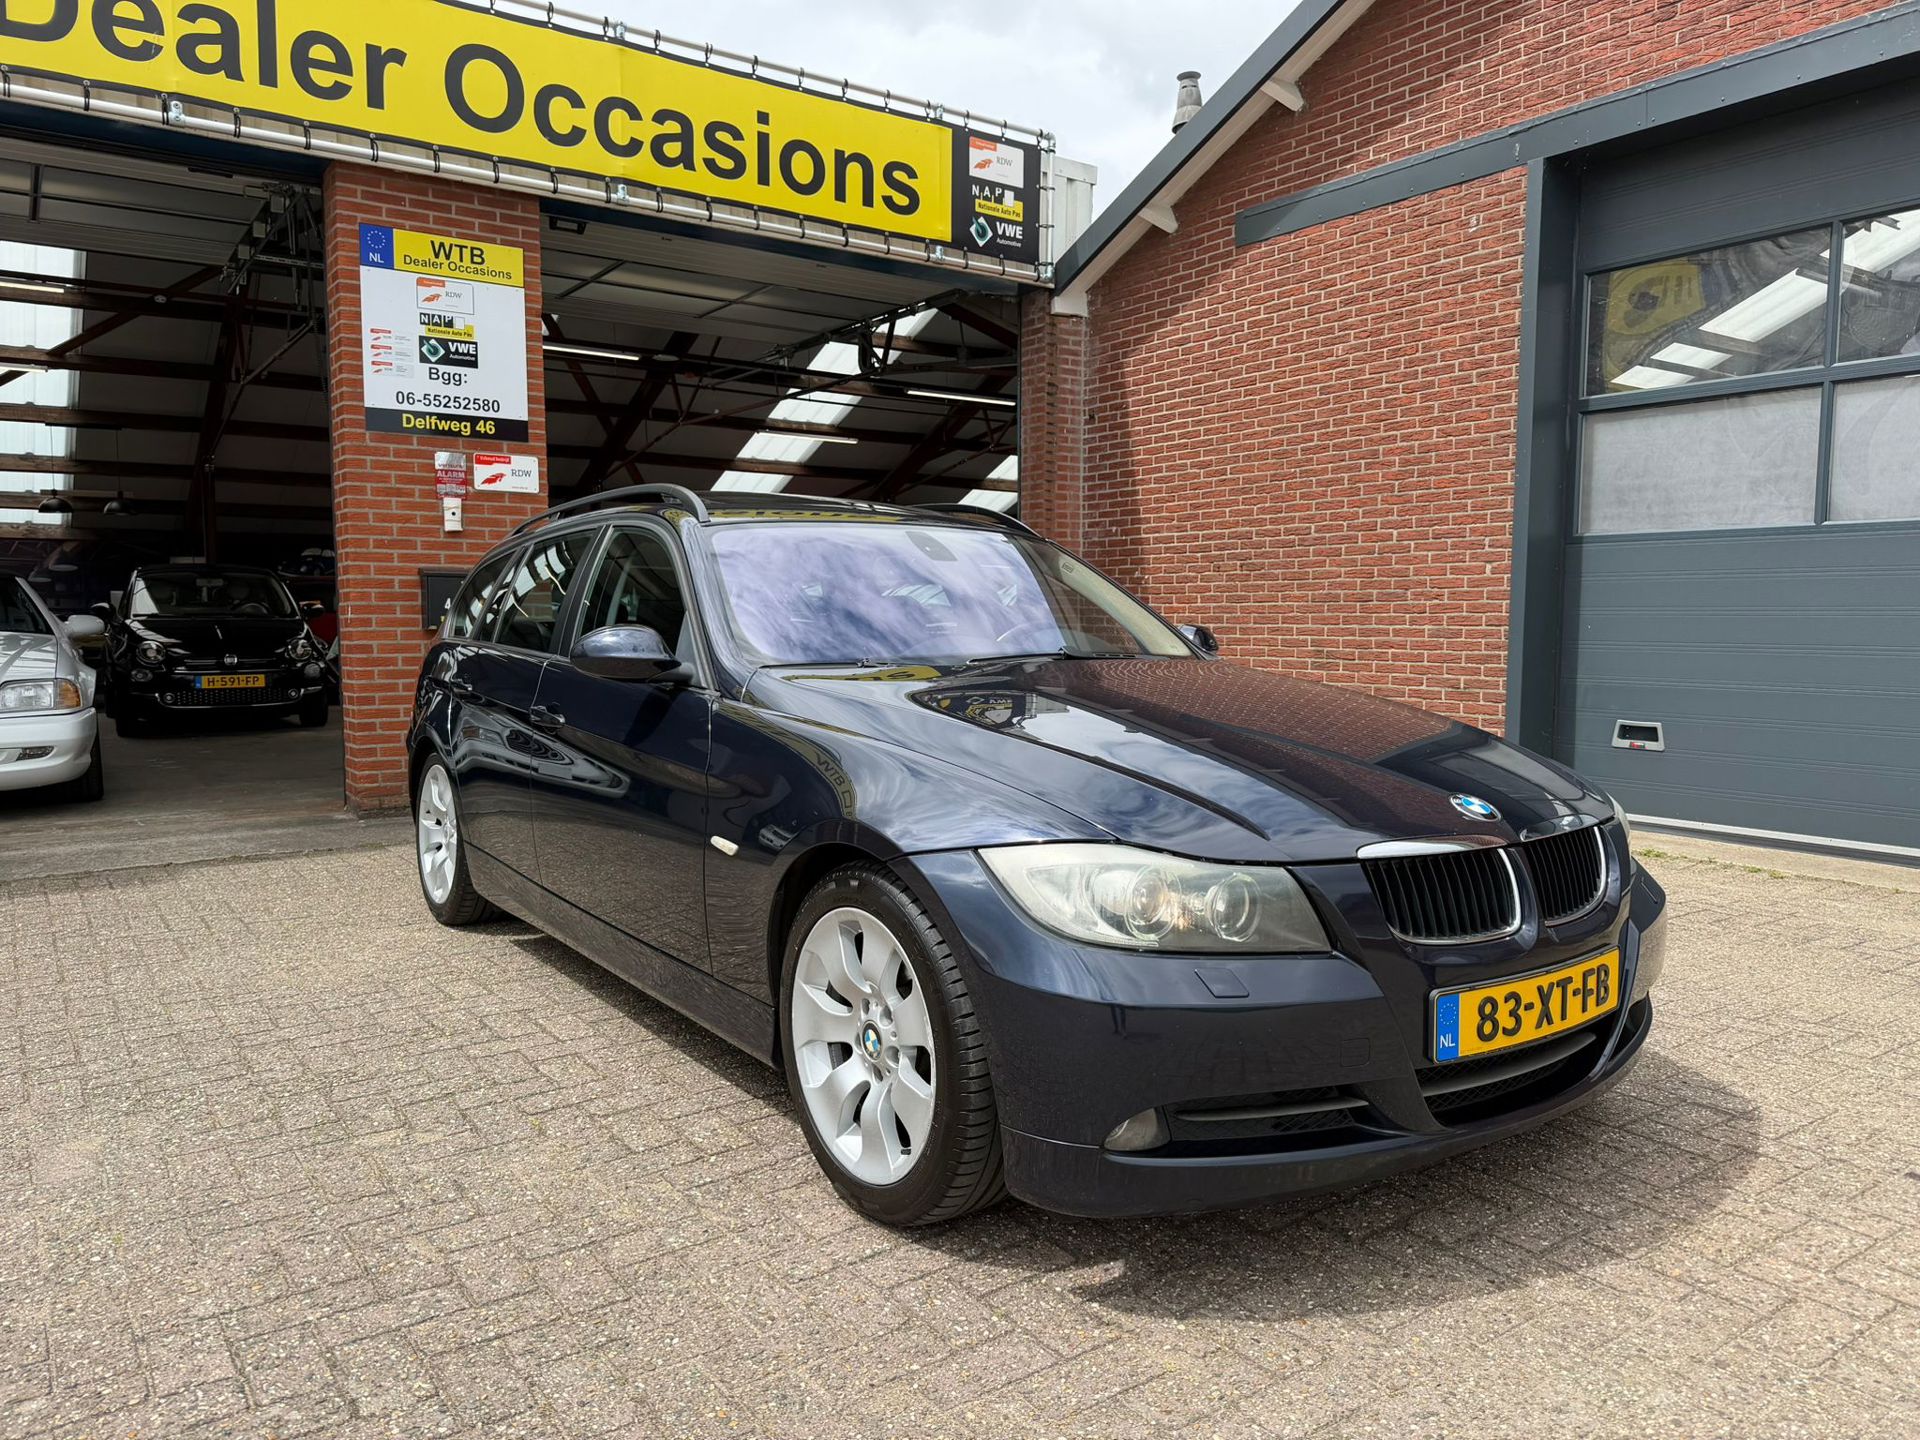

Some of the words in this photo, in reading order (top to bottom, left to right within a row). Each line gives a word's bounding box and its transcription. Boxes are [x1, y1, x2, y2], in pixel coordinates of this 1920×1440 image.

[444, 43, 920, 216] Occasions
[978, 203, 1000, 214] Nationale
[1000, 207, 1012, 216] Auto
[1012, 210, 1021, 218] Pas
[996, 221, 1023, 239] VWE
[996, 238, 1021, 248] Automotive
[369, 252, 384, 264] NL
[430, 240, 486, 265] WTB
[403, 254, 444, 271] Dealer
[447, 261, 512, 280] Occasions
[448, 341, 477, 355] VWE
[449, 353, 476, 361] Automotive
[428, 367, 468, 386] Bgg:
[396, 391, 500, 413] 06-55252580
[402, 413, 471, 436] Delfweg
[475, 420, 496, 435] 46
[437, 470, 465, 479] ALARM
[511, 469, 532, 478] RDW
[207, 676, 260, 687] H-591-FP
[1476, 963, 1610, 1043] 83-XT-FB
[1440, 1033, 1456, 1048] NL
